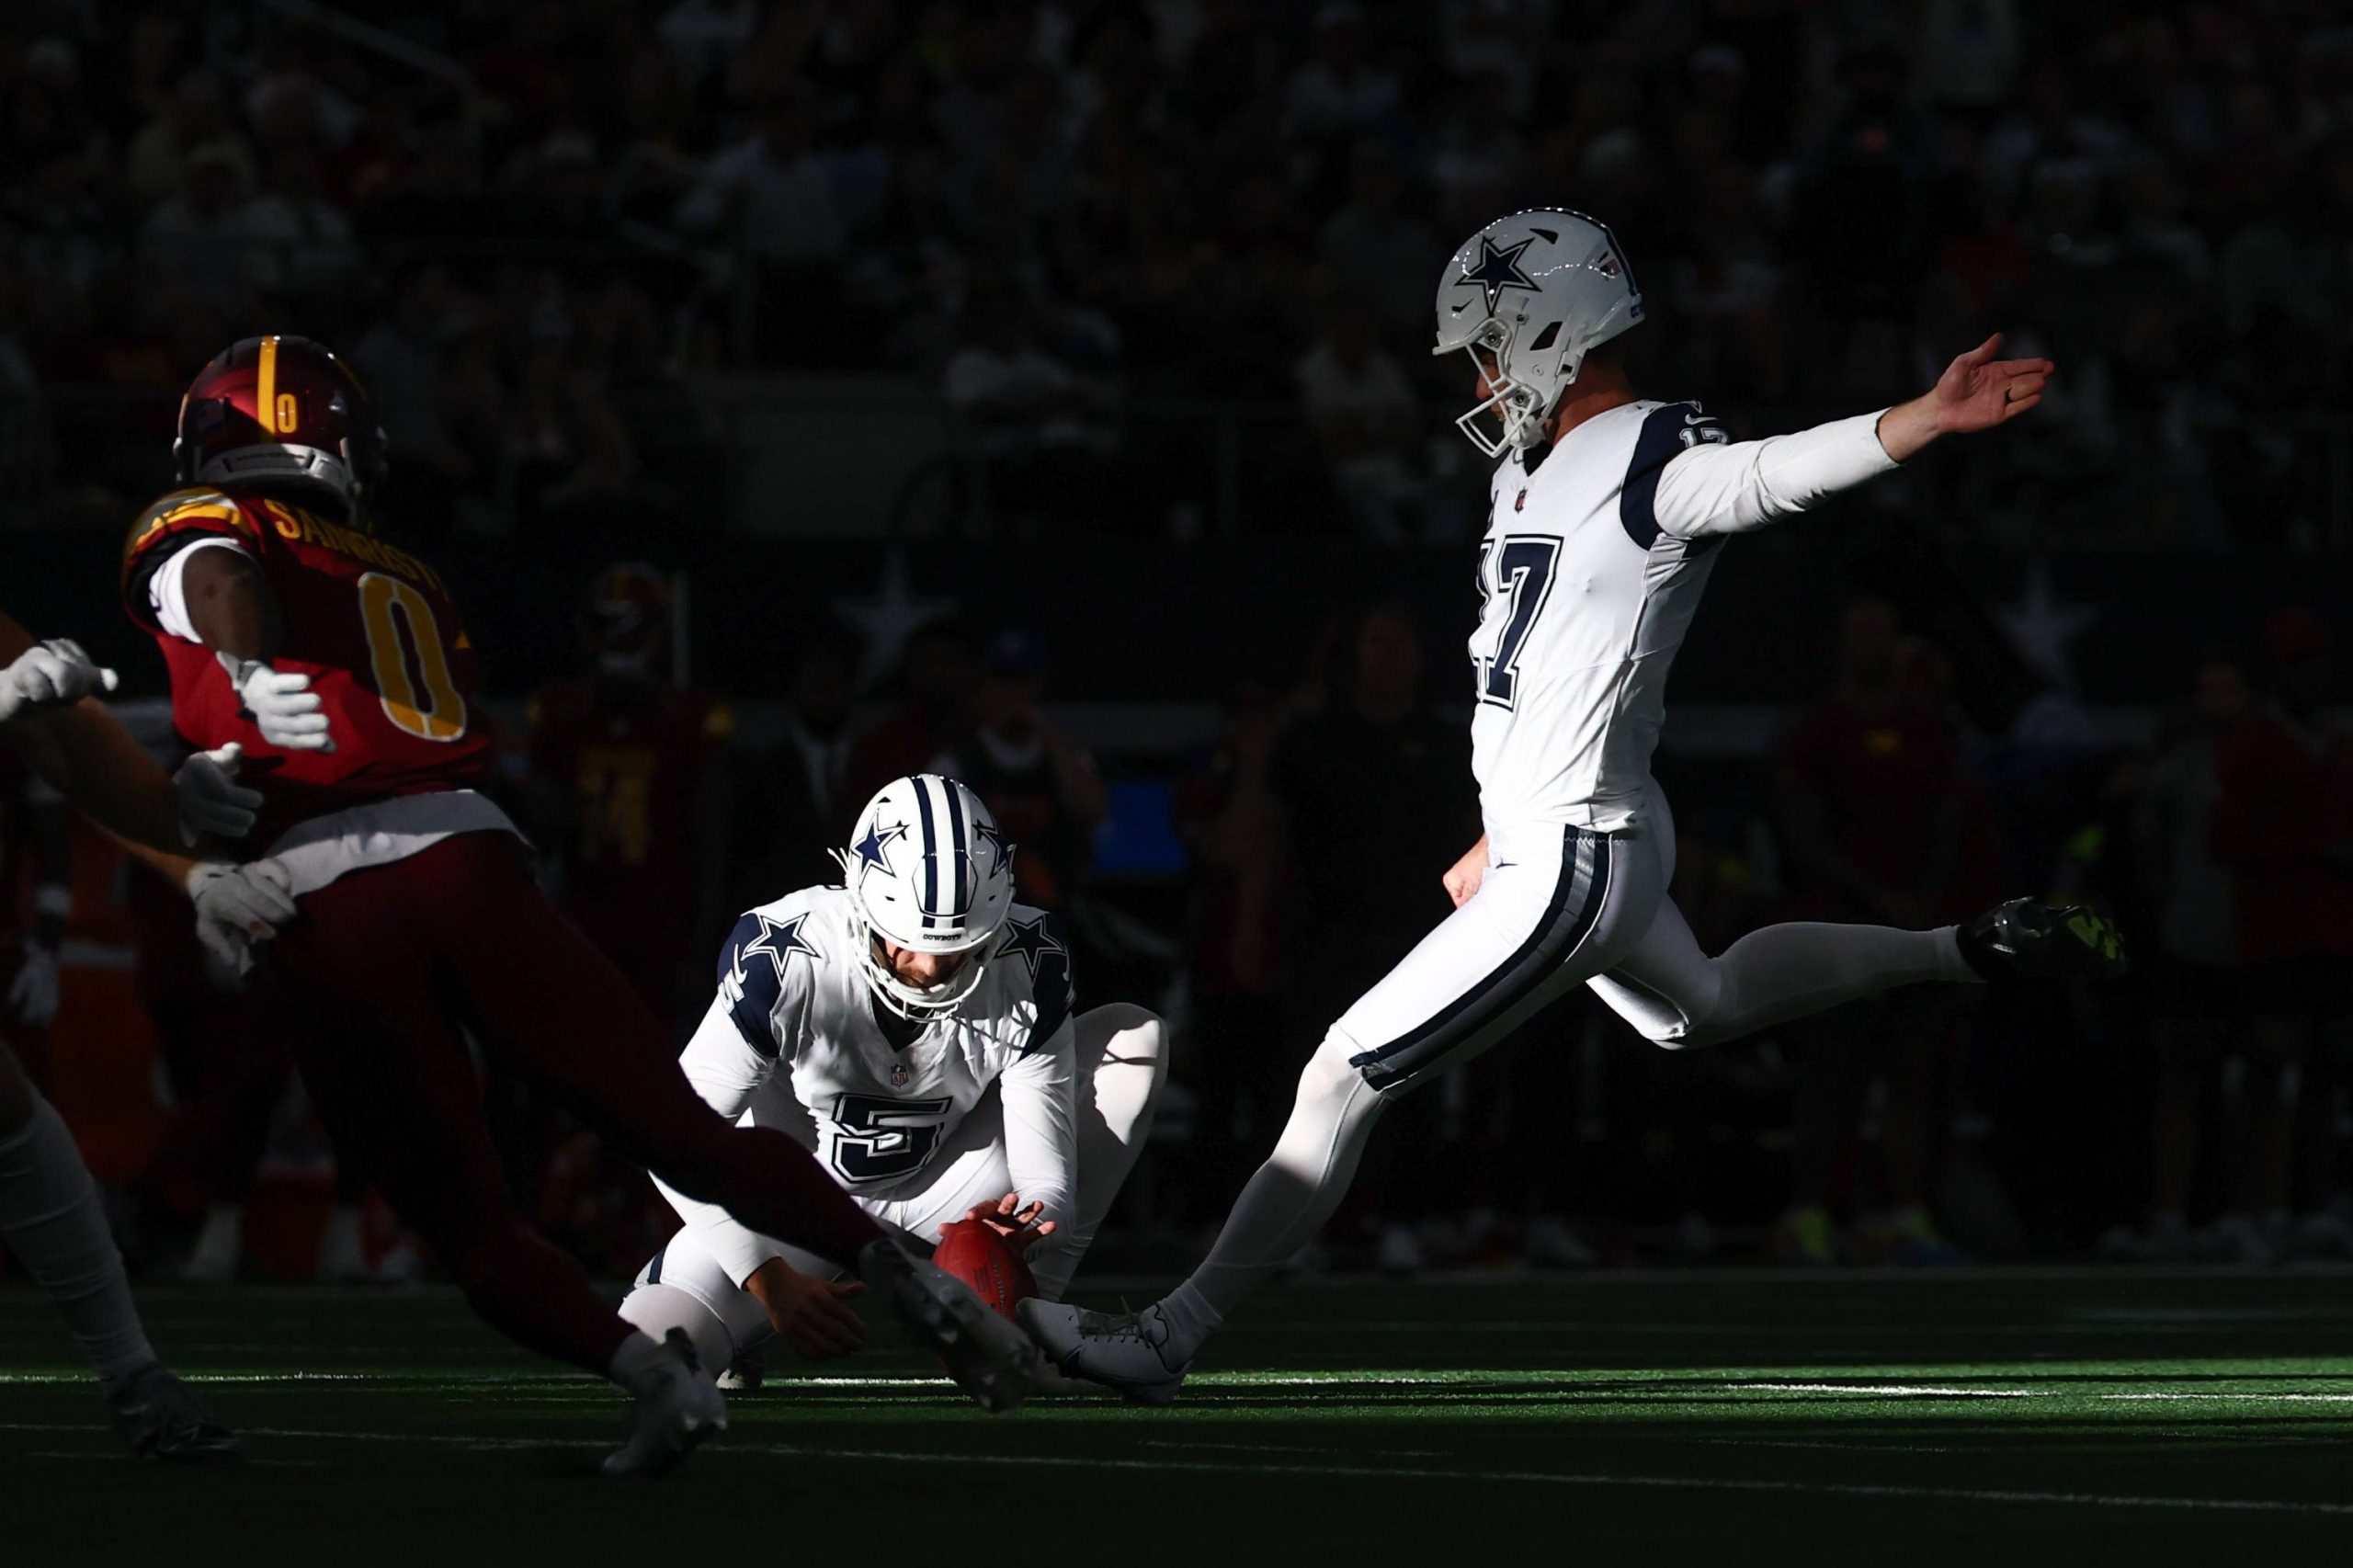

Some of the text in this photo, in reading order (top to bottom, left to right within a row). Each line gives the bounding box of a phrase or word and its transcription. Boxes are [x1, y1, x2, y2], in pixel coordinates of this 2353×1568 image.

[277, 393, 297, 433] 0
[358, 572, 467, 743] 0
[831, 1091, 953, 1184] 5
